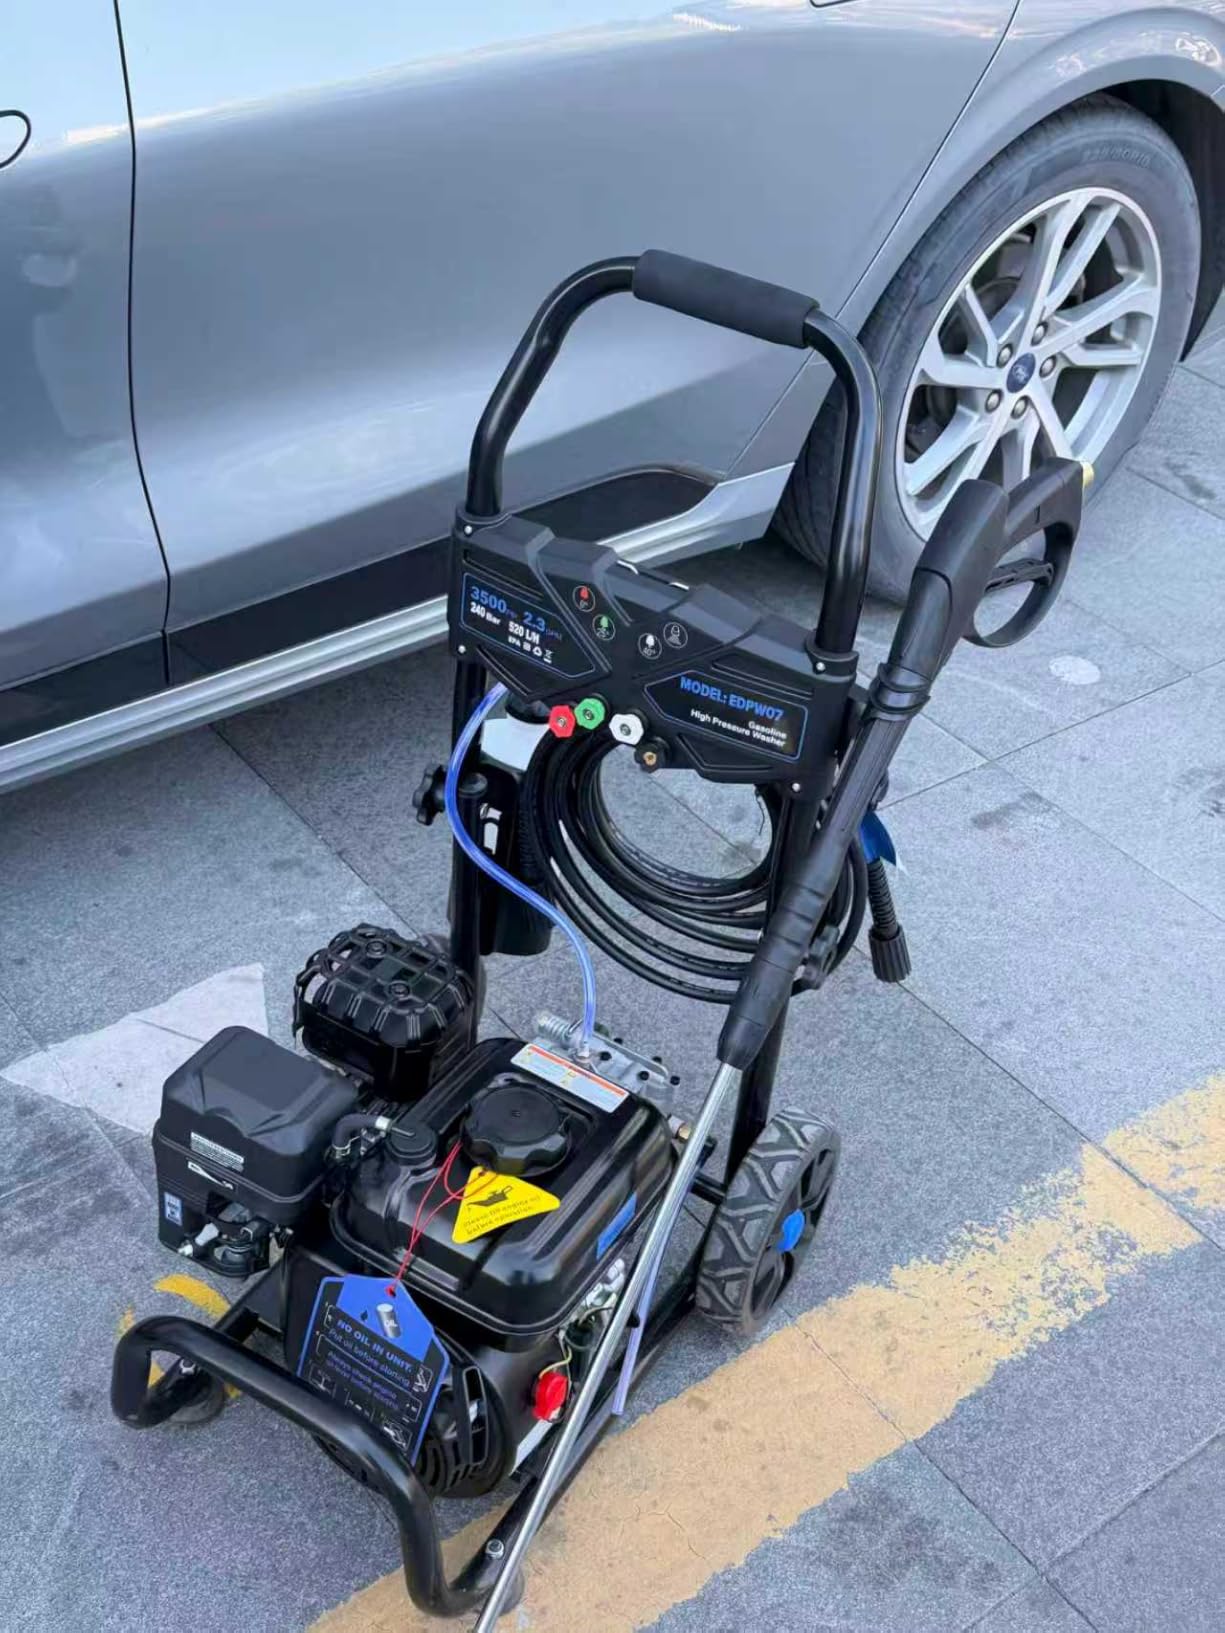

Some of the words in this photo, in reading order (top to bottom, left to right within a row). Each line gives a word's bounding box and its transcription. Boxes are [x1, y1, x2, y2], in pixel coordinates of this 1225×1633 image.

[470, 586, 507, 613] 3500
[523, 611, 545, 632] 2.3
[470, 601, 486, 618] 240
[508, 620, 524, 637] 520
[680, 676, 727, 704] MODEL:
[729, 694, 784, 721] EDPW07
[690, 709, 712, 724] High
[712, 717, 751, 736] Pressure
[752, 730, 787, 748] Washer
[748, 721, 787, 739] Gasoline
[337, 1319, 353, 1333] NO
[353, 1330, 370, 1348] OIL
[372, 1343, 385, 1356] IN
